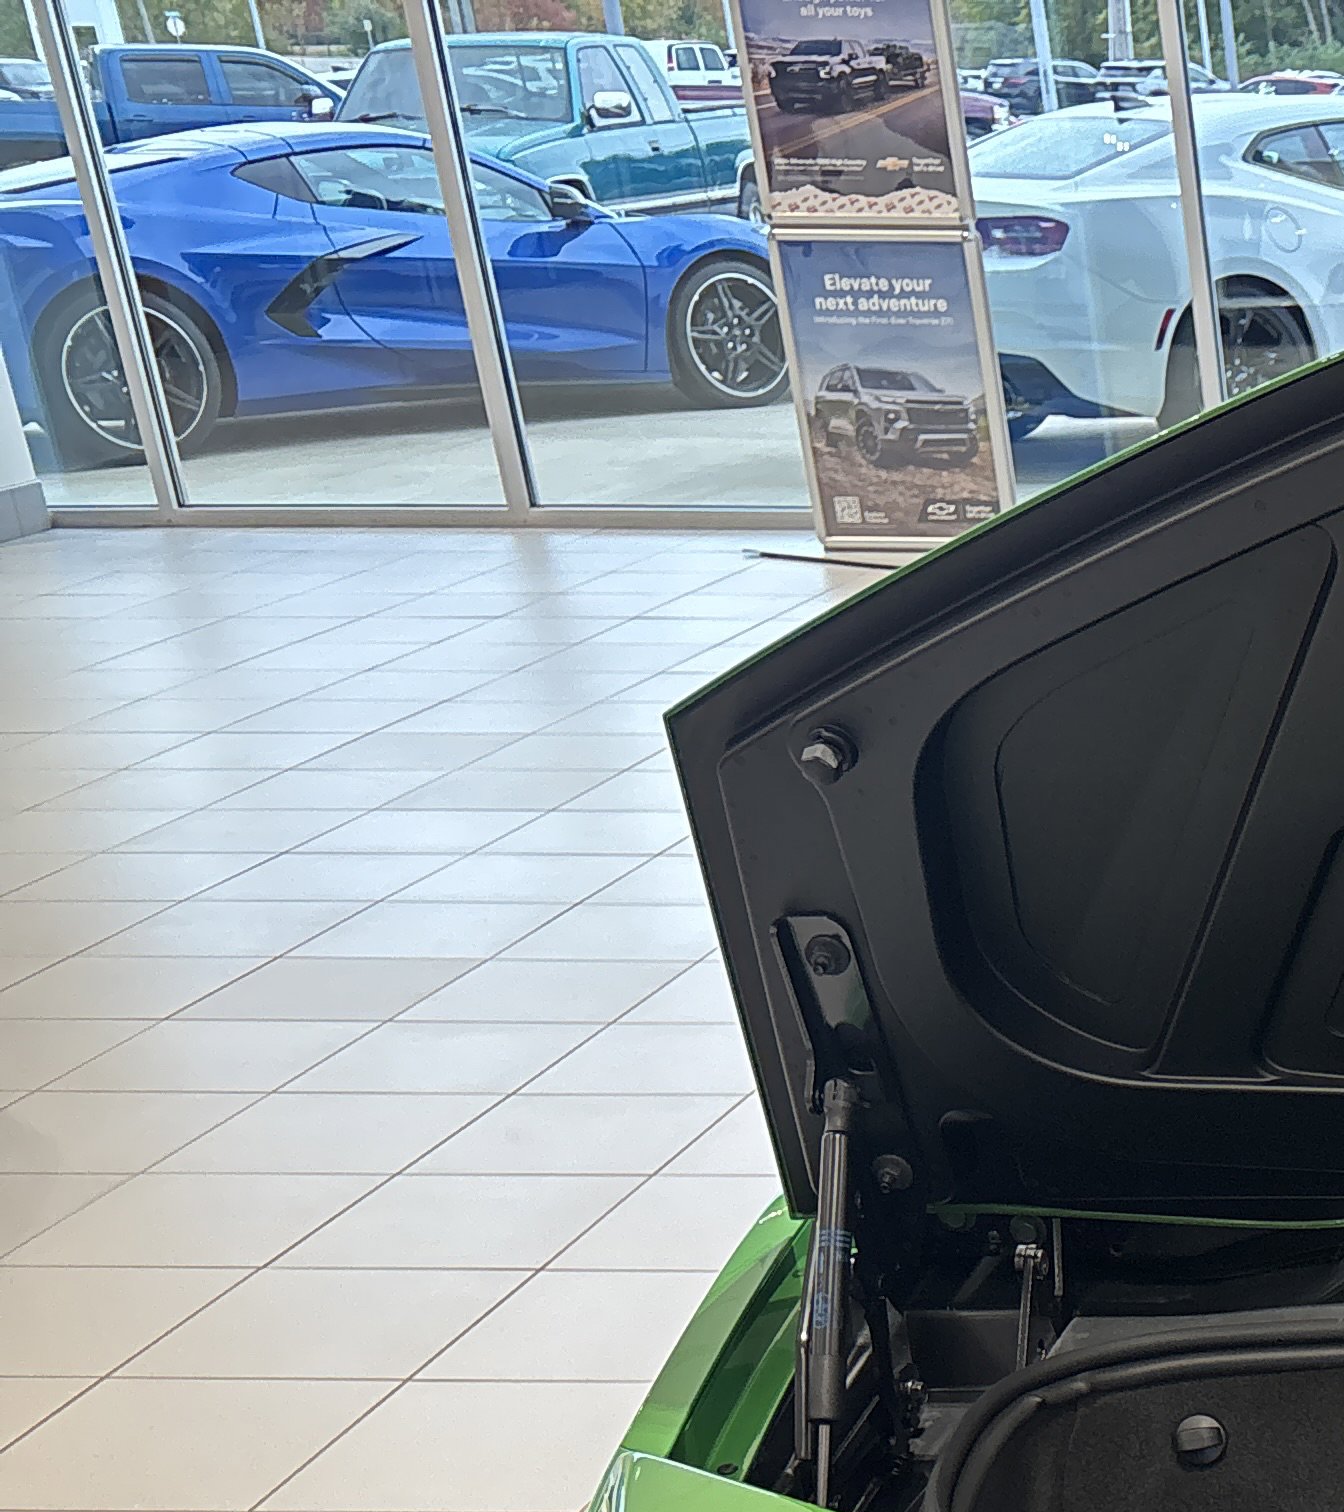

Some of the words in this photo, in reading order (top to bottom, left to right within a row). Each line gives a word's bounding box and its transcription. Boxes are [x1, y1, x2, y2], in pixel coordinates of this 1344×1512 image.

[817, 7, 844, 18] your
[846, 6, 874, 19] toys
[823, 272, 890, 292] Elevate
[892, 277, 933, 295] your
[814, 295, 854, 312] next
[857, 294, 948, 313] adventure
